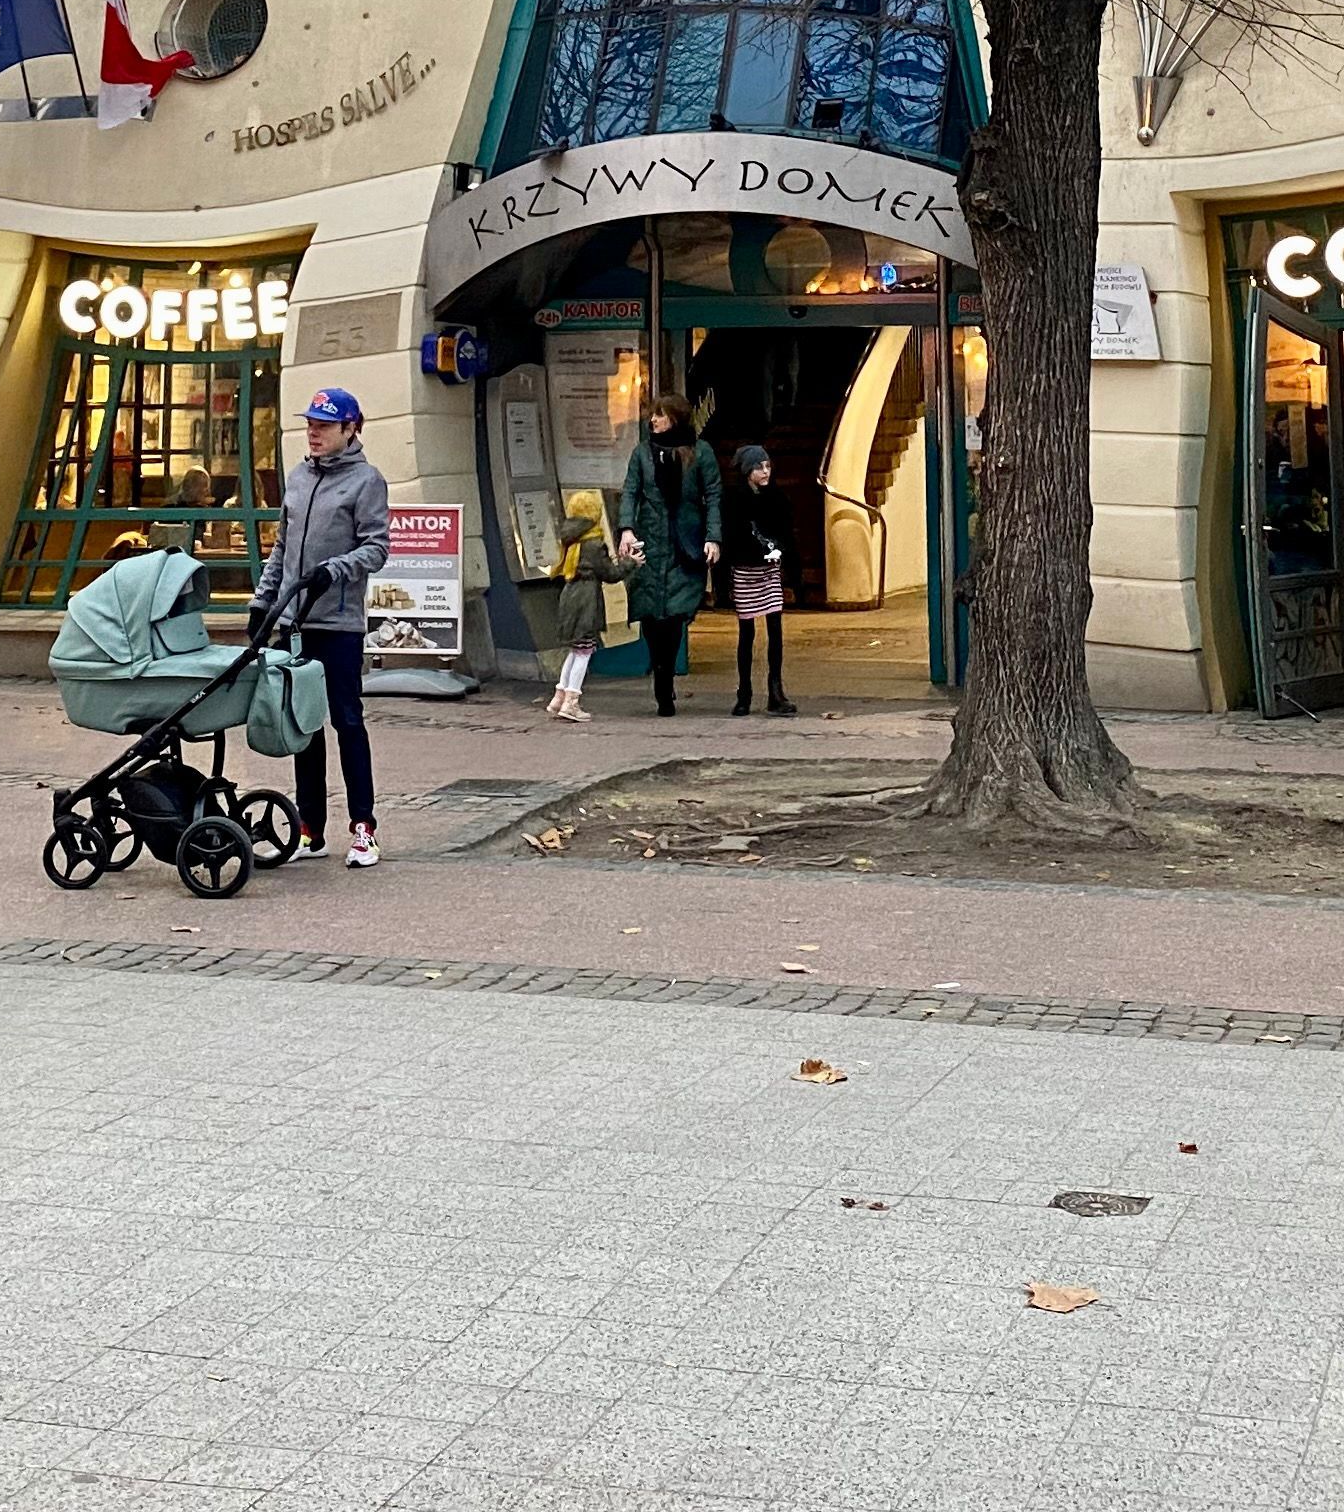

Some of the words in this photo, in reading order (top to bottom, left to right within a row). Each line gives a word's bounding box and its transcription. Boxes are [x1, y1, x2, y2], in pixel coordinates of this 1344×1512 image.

[232, 105, 335, 153] HOSPES
[468, 157, 716, 250] KRZYWY
[738, 159, 955, 238] DOMEK
[58, 279, 290, 341] COFFEE
[537, 311, 560, 325] 24h
[563, 302, 642, 319] KANTOR
[389, 516, 452, 531] ANTOR
[417, 621, 453, 629] LOMBARD
